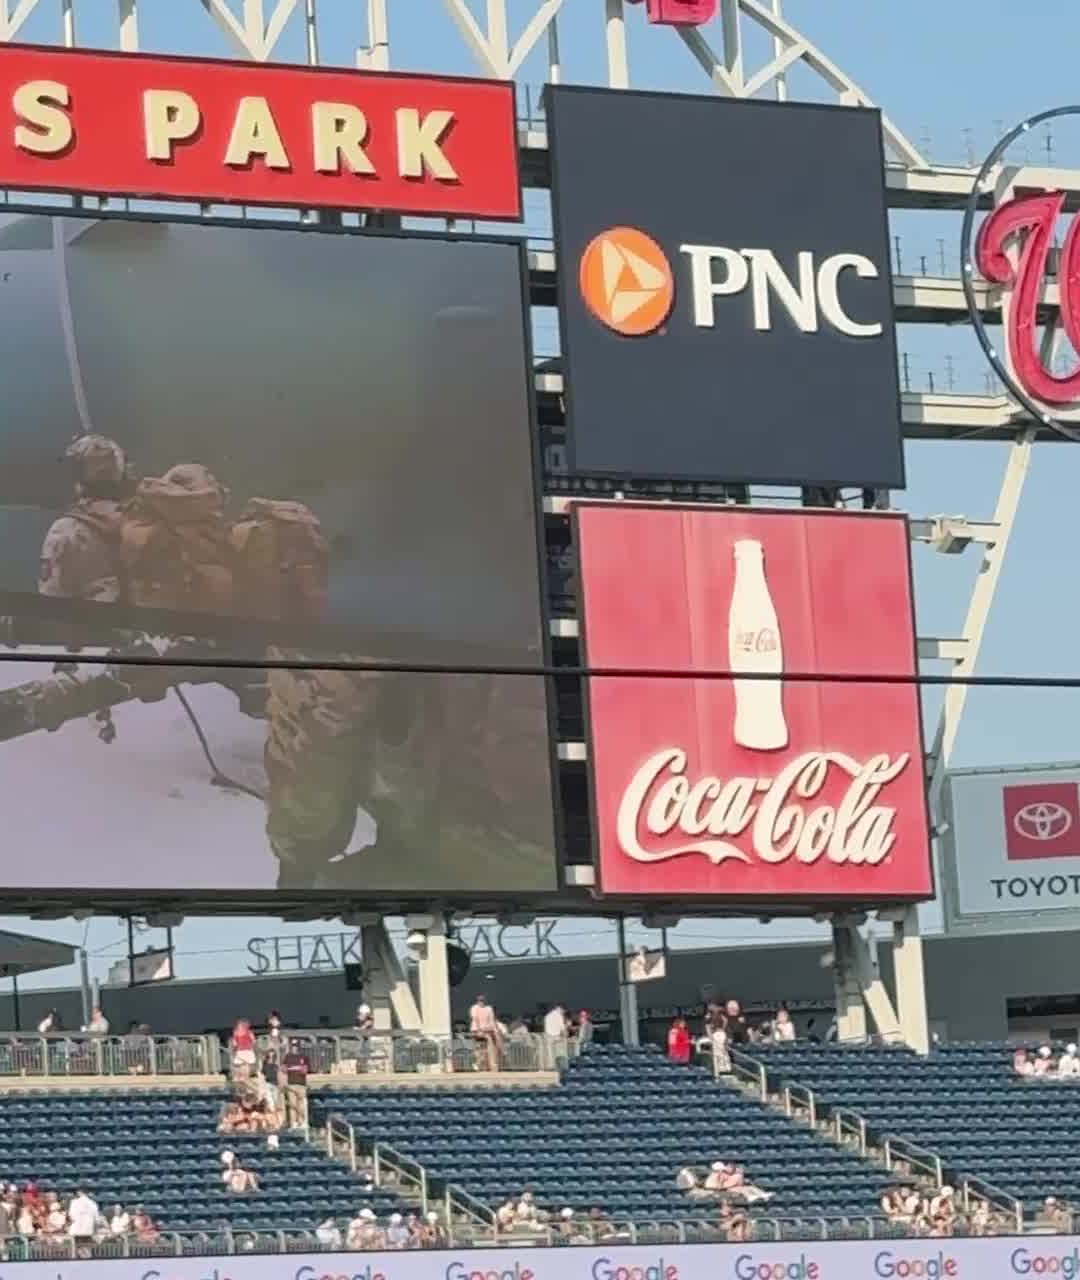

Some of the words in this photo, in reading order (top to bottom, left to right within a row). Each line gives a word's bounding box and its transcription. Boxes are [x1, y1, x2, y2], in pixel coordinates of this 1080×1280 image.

[142, 88, 457, 182] PARK
[680, 244, 884, 337] PNC
[617, 748, 910, 866] Coca-Cola
